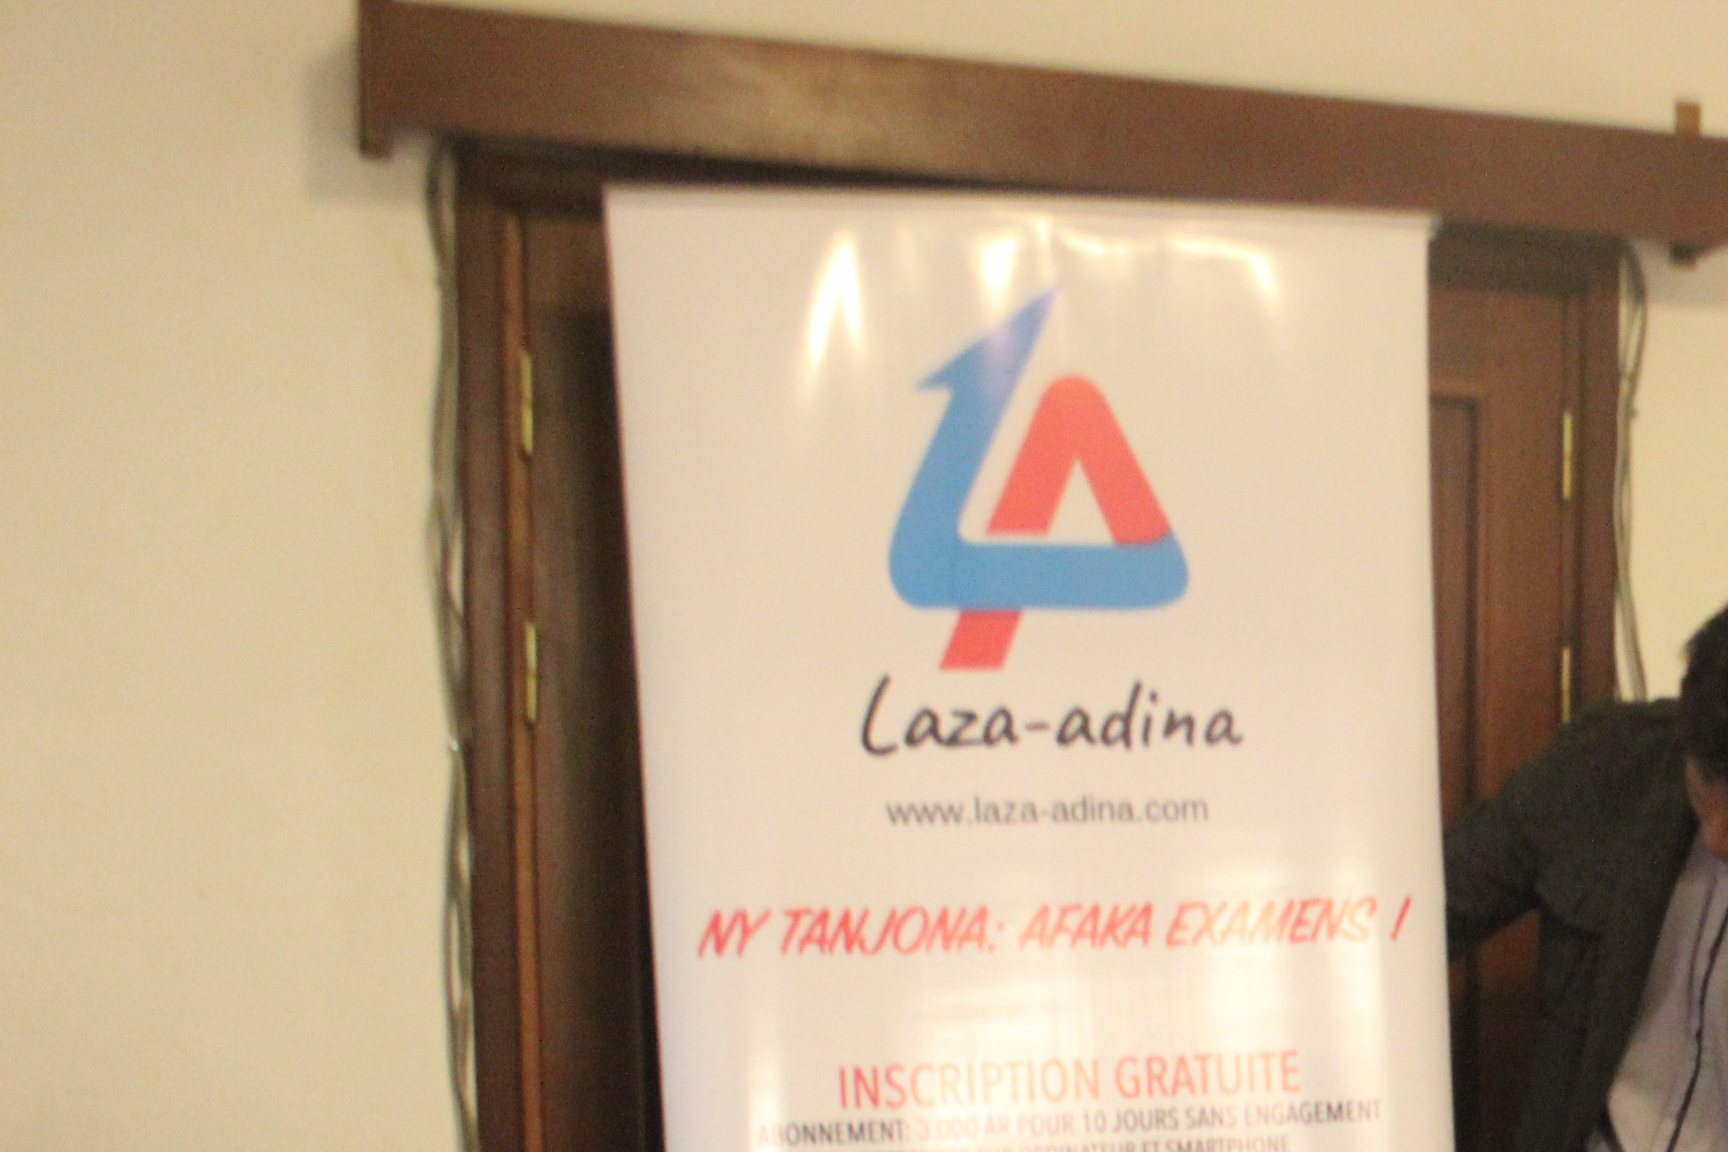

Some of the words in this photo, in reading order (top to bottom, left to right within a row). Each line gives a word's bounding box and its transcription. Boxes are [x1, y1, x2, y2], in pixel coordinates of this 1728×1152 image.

[859, 674, 1243, 756] Laza-adina
[886, 795, 1209, 826] www.laza-adina.com
[697, 908, 773, 960] NY
[1018, 901, 1154, 950] AFAKA
[1166, 895, 1378, 948] EXAMENS
[838, 1058, 1101, 1110] INSCRIPTION
[1114, 1050, 1302, 1099] GRATUITE
[1017, 1111, 1075, 1136] POUR
[1082, 1110, 1107, 1134] 10
[1112, 1106, 1179, 1133] JOURS
[1185, 1103, 1238, 1130] SANS
[1243, 1098, 1383, 1127] ENGAGEMENT
